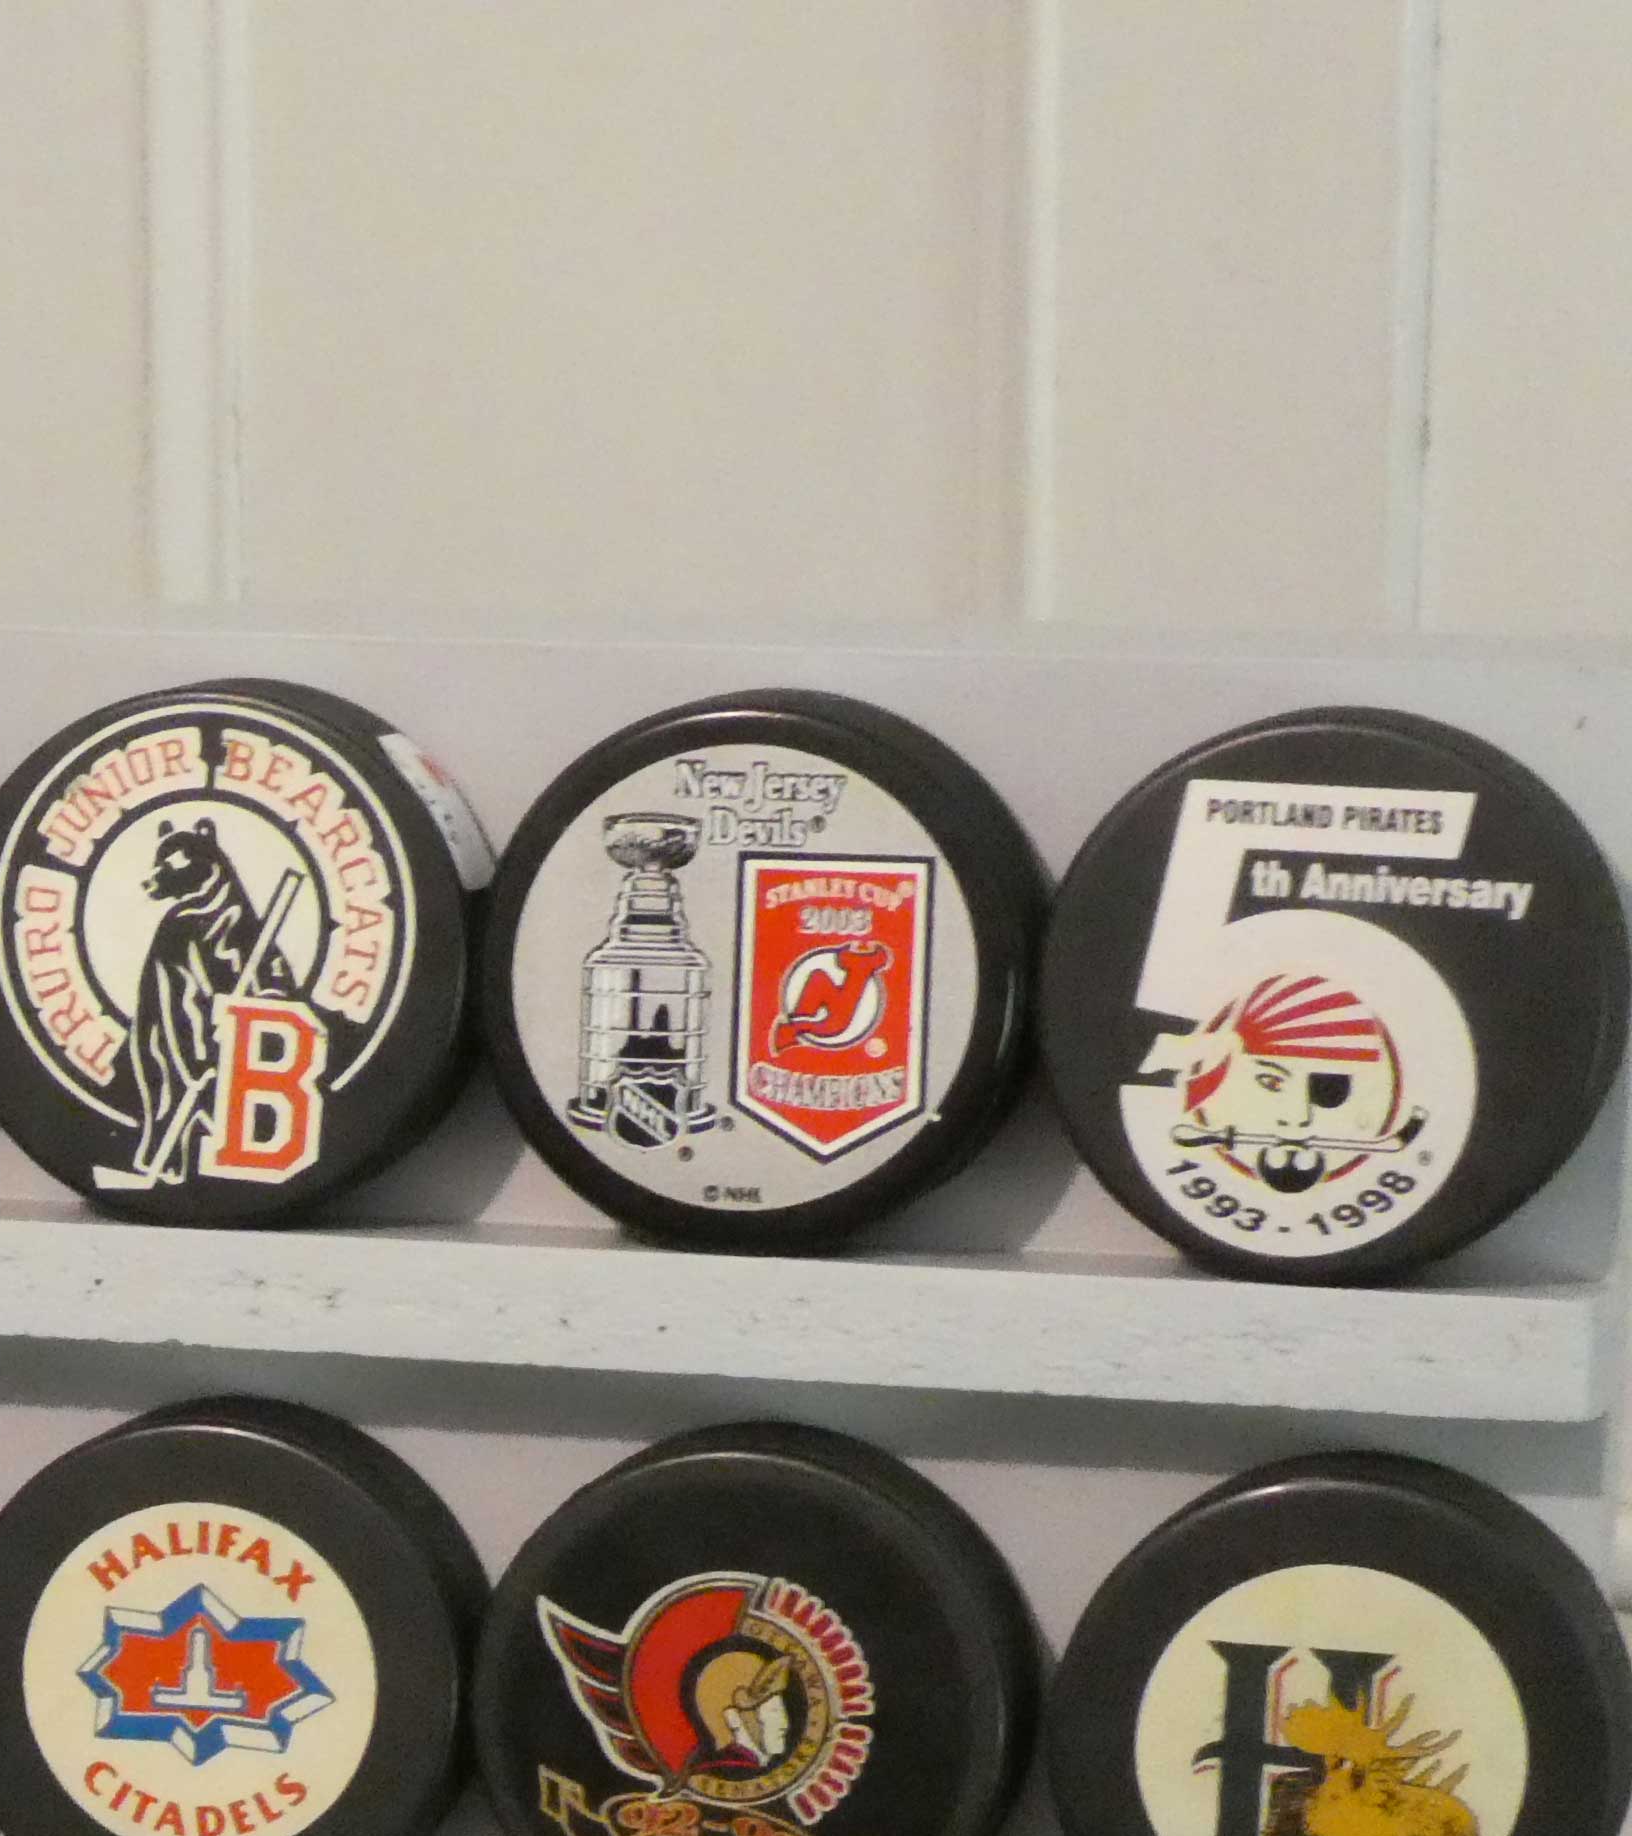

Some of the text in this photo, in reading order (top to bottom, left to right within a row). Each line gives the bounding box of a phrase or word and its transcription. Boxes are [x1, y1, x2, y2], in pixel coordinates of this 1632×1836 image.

[674, 759, 847, 814] New Jersey
[1206, 798, 1444, 835] PORTLAND PIRATES
[24, 737, 384, 1078] TRURO JUNIOR BEARCATS
[765, 878, 858, 909] STANLEY
[1300, 862, 1534, 920] Anniversary
[214, 1001, 320, 1172] B
[87, 1521, 316, 1602] HALIFAX
